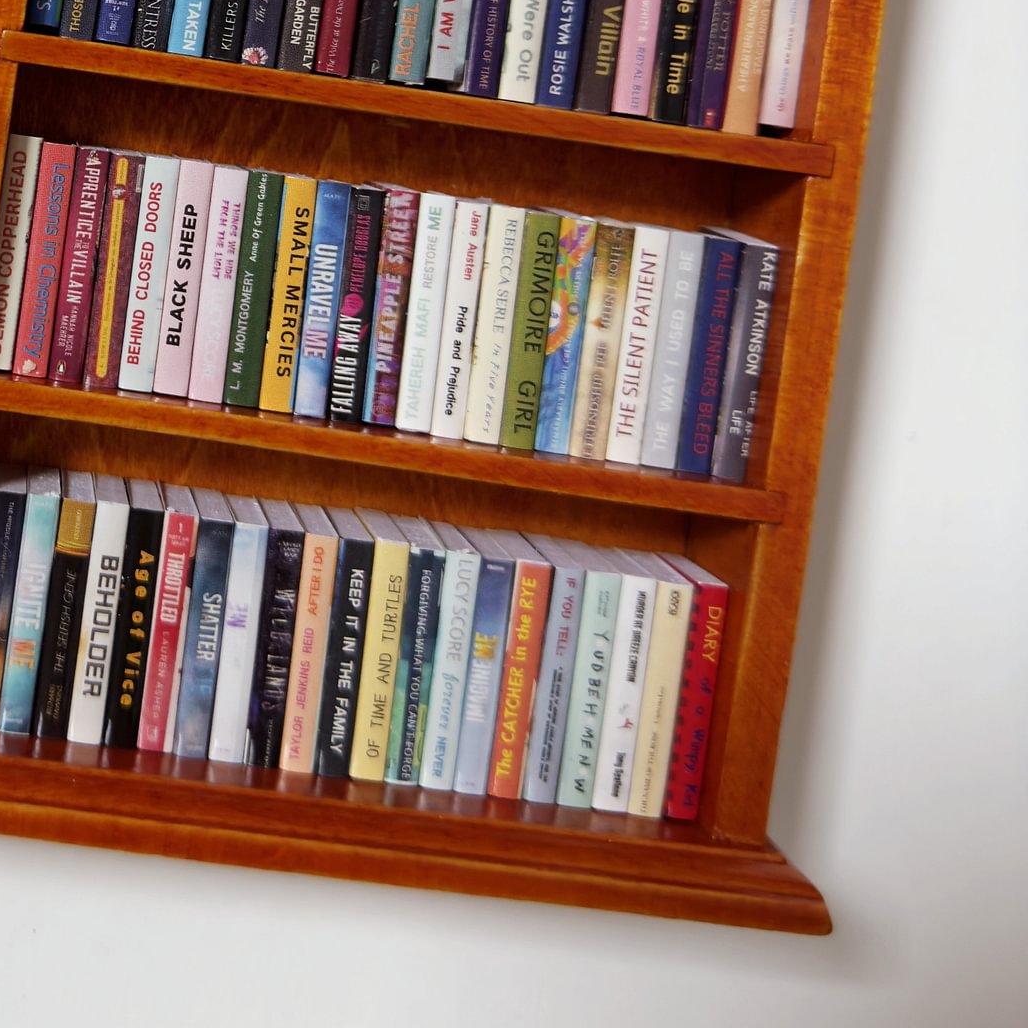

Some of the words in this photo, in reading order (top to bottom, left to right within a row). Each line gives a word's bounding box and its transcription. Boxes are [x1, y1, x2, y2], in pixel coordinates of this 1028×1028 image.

[181, 0, 202, 51] TAKEN
[220, 1, 239, 51] KILLERS
[301, 5, 320, 69] BUTTERFLY
[438, 11, 454, 37] AM
[595, 3, 620, 77] Villain
[673, 24, 690, 40] in
[549, 49, 566, 95] ROSIE
[665, 49, 688, 95] Time
[43, 162, 68, 236] Lessons
[144, 181, 162, 232] DOORS
[176, 203, 198, 270] SHEEP
[287, 206, 310, 277] SMALL
[469, 210, 481, 237] Jane
[42, 240, 58, 258] in
[135, 240, 154, 300] CLOSED
[463, 242, 477, 281] Austen
[758, 250, 776, 291] KATE
[304, 242, 339, 327] UNRAVEL
[522, 230, 556, 354] GRIMOIRE
[26, 263, 54, 359] Chemistry
[165, 279, 188, 347] BLACK
[234, 269, 255, 353] MONTGOMERY
[274, 284, 301, 378] MERCIES
[455, 305, 467, 333] Pride
[127, 309, 145, 365] BEHIND
[303, 329, 329, 359] ME
[452, 339, 462, 360] and
[745, 299, 768, 377] ATKINSON
[229, 378, 240, 390] L.
[231, 358, 243, 373] M.
[443, 365, 459, 416] Prejudice
[512, 379, 536, 436] GIRL
[132, 549, 154, 599] Age
[313, 546, 324, 564] DO
[62, 569, 77, 603] GENE
[159, 550, 185, 623] THROTTLED
[307, 575, 321, 615] AFTER
[346, 567, 364, 608] KEEP
[518, 576, 537, 609] RYE
[565, 577, 576, 588] IF
[56, 605, 72, 649] SELFISH
[82, 554, 119, 698] BEHOLDER
[128, 610, 147, 639] of
[344, 614, 359, 629] IT
[381, 573, 403, 643] TURTLES
[514, 614, 531, 641] the
[560, 594, 574, 619] YOU
[302, 627, 314, 654] REID
[341, 635, 356, 652] IN
[511, 645, 527, 661] in
[700, 605, 722, 662] DIARY
[53, 651, 66, 673] THE
[119, 649, 140, 707] Vice
[336, 658, 353, 689] THE
[376, 651, 392, 684] AND
[295, 660, 310, 709] JENKINS
[500, 666, 524, 743] CATCHER
[329, 696, 348, 755] FAMILY
[370, 693, 387, 727] TIME
[288, 715, 304, 760] TAYLOR
[365, 739, 381, 758] OF
[495, 747, 513, 777] The
